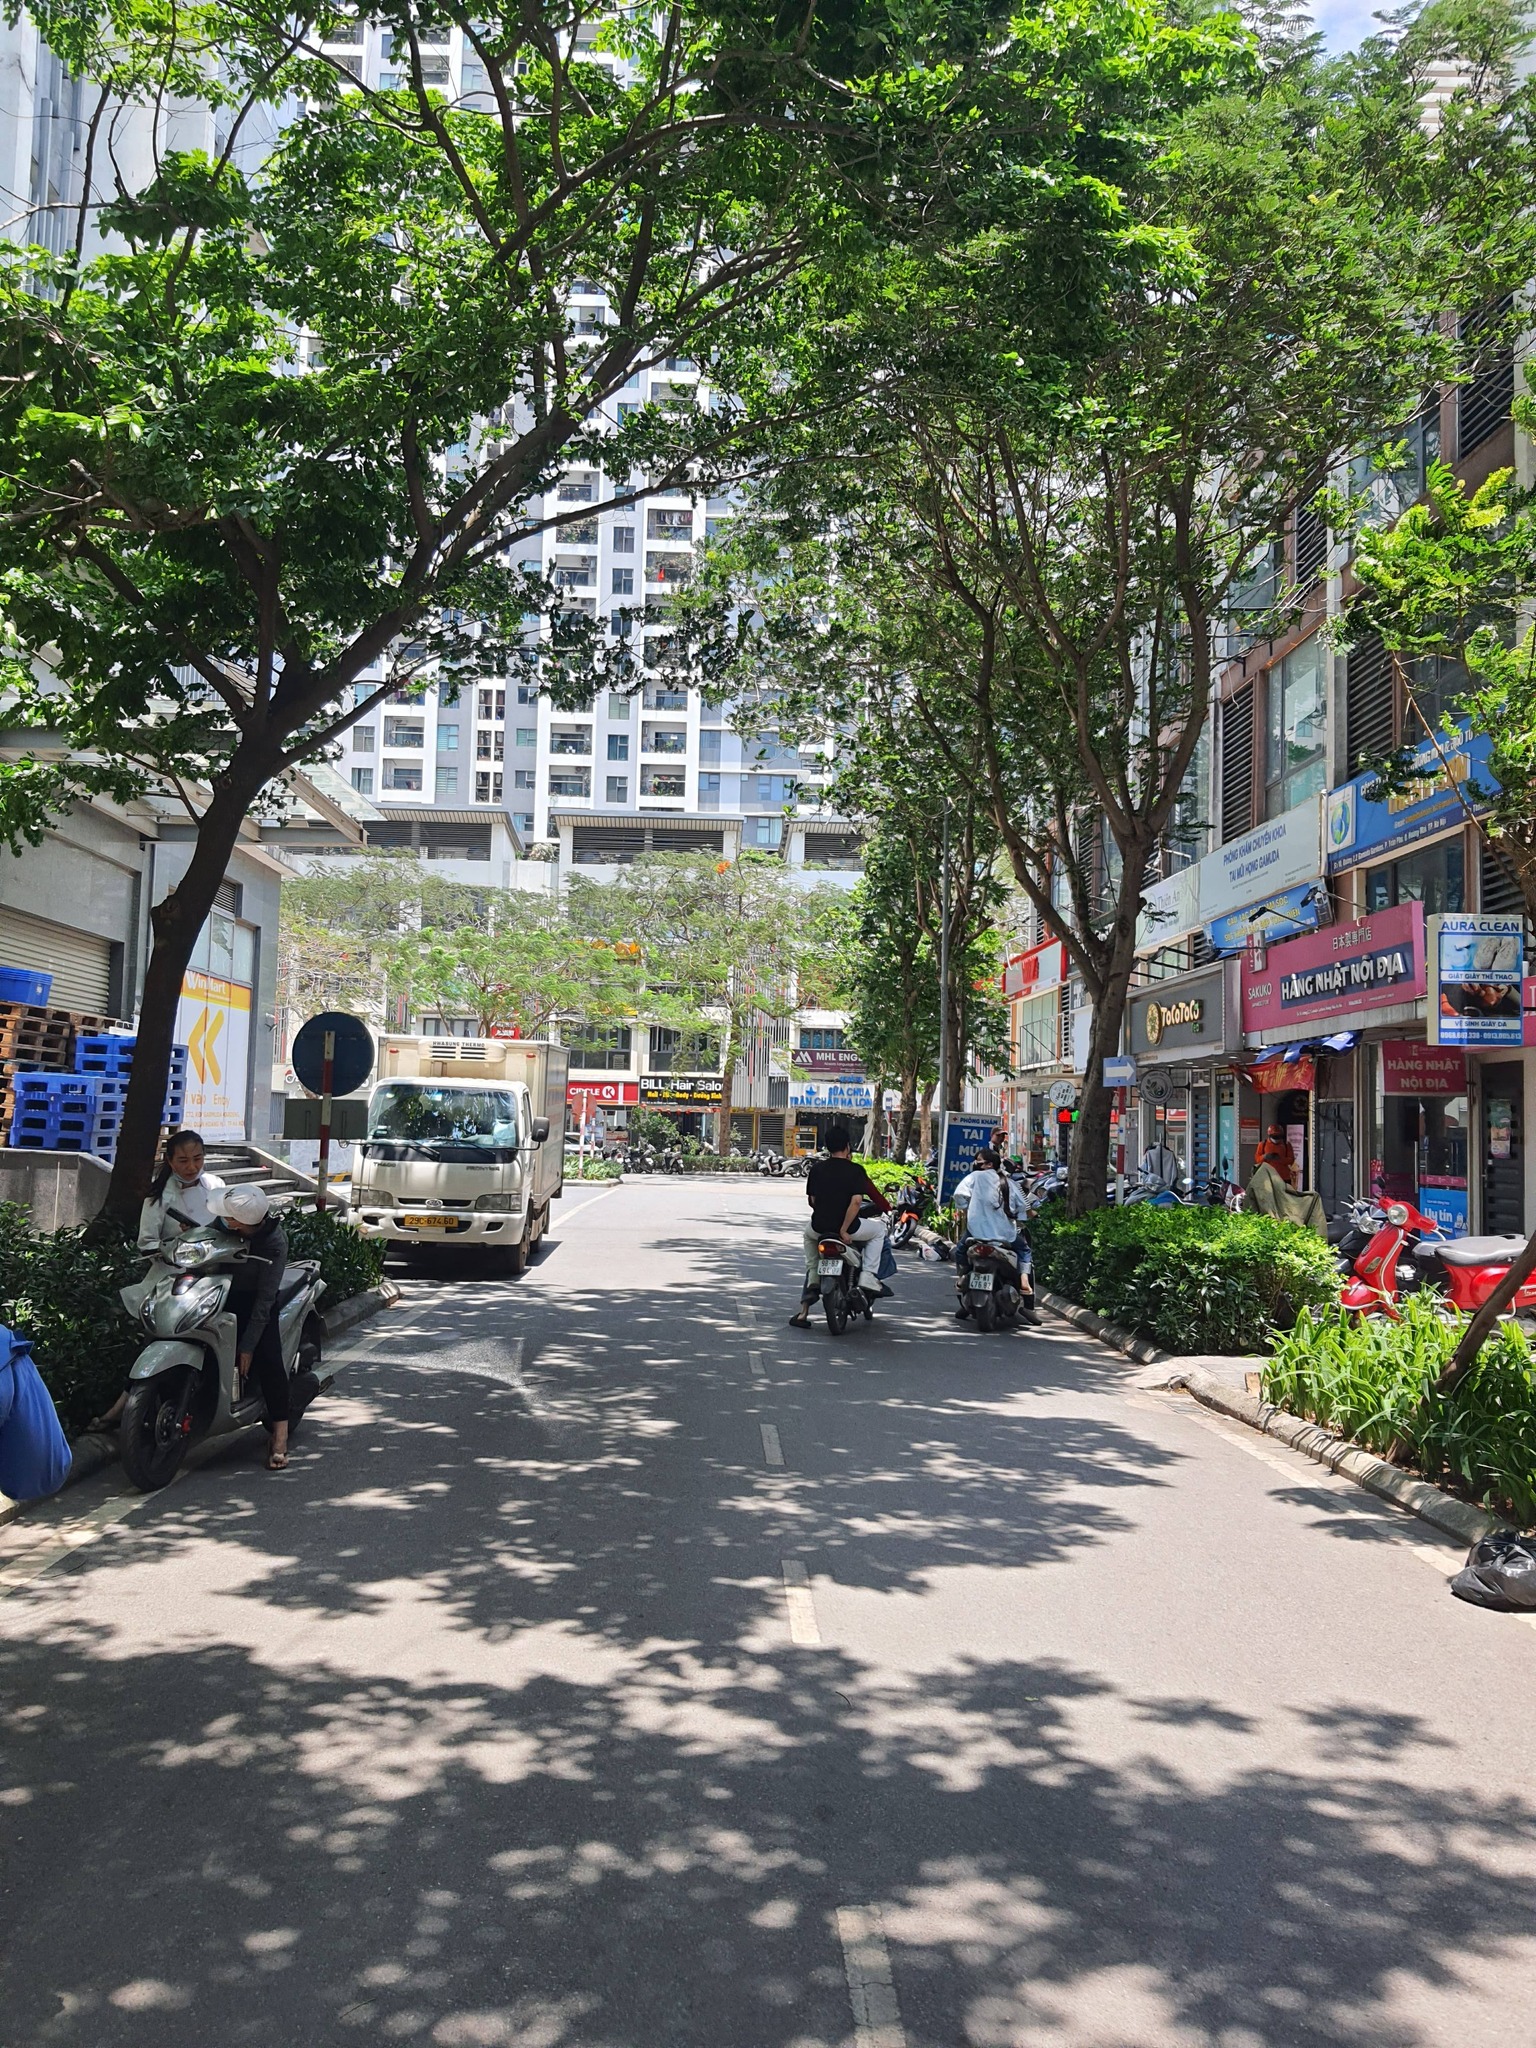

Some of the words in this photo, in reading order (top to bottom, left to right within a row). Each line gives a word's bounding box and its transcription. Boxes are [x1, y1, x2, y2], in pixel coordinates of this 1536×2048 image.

[1272, 823, 1287, 841] KHOA
[1441, 921, 1476, 931] AURA
[1480, 921, 1519, 932] CLEAN
[1281, 973, 1313, 1000] HÀNG
[1315, 961, 1350, 996] NHẬT
[1350, 953, 1374, 989] NỘI
[1377, 952, 1407, 984] ĐỊA
[1248, 982, 1272, 1000] SAKUKO
[816, 1052, 836, 1061] MHL
[1387, 1057, 1423, 1071] HÀNG
[1425, 1057, 1460, 1073] NHẬT
[640, 1078, 665, 1090] BILL
[671, 1079, 695, 1090] Hair
[697, 1079, 724, 1091] Salo
[1400, 1075, 1423, 1090] NỘI
[1425, 1078, 1449, 1090] ĐỊA
[960, 1116, 980, 1124] PHÒNG
[981, 1117, 998, 1125] KHÁM
[963, 1128, 983, 1140] TAI
[1439, 1209, 1453, 1222] tín
